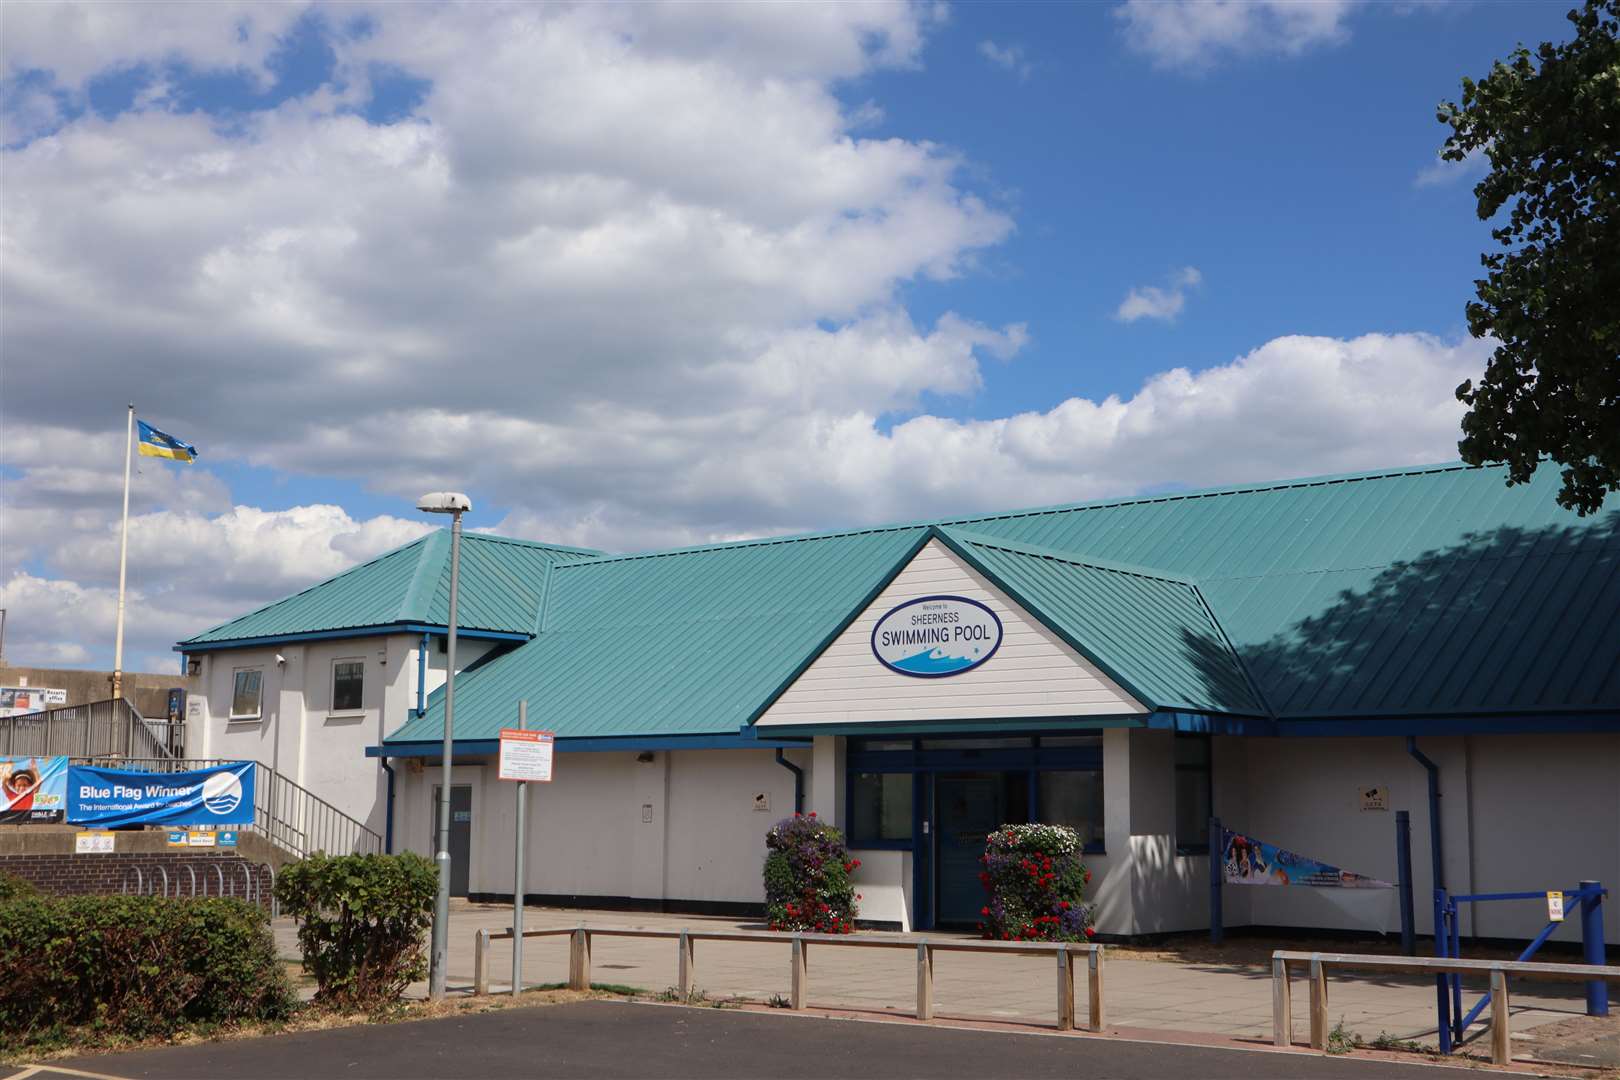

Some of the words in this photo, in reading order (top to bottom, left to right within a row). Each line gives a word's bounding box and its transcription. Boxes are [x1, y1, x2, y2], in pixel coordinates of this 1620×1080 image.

[911, 612, 959, 626] SHEERNESS
[882, 627, 949, 647] SWIMMING
[954, 624, 991, 642] POOL
[79, 786, 111, 799] Blue
[113, 785, 142, 800] Flag
[145, 784, 192, 798] Winner
[93, 803, 132, 811] International
[133, 802, 155, 810] Award
